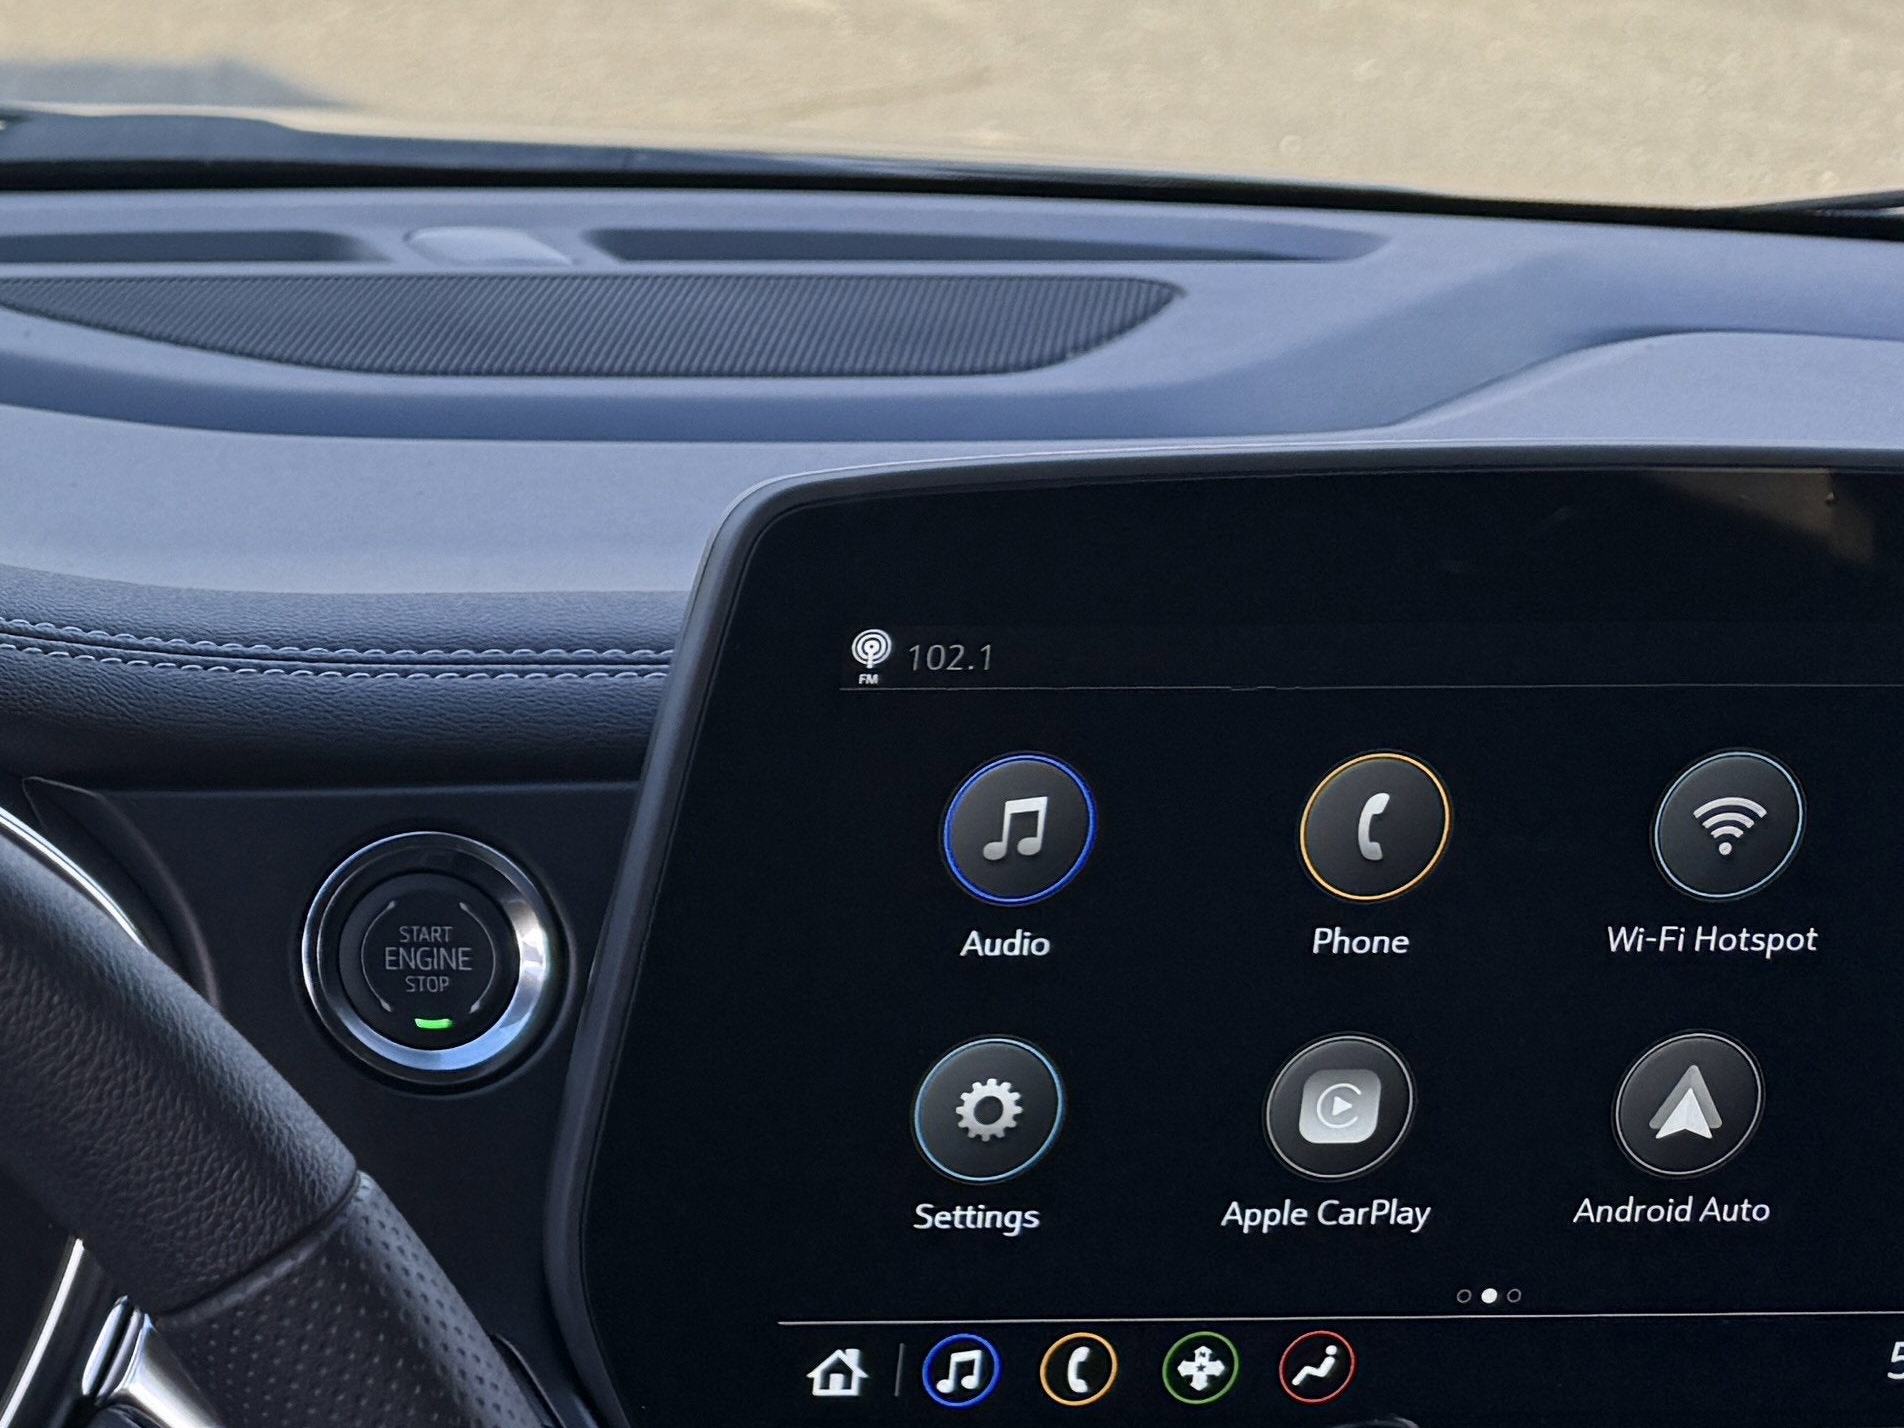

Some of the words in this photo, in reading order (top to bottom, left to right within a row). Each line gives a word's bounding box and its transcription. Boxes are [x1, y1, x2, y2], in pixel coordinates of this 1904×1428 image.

[907, 643, 992, 672] 102.1
[858, 673, 879, 685] FM
[399, 926, 452, 943] START
[959, 928, 1051, 958] Audio
[1311, 926, 1410, 955] Phone
[1607, 924, 1686, 954] Wi-Fi
[1695, 925, 1818, 960] Hotspot
[385, 947, 472, 971] ENGINE
[405, 975, 450, 993] STOP
[912, 1203, 1041, 1237] Settings
[1221, 1201, 1308, 1234] Apple
[1317, 1199, 1432, 1233] CarPlay
[1573, 1196, 1693, 1224] Android
[1699, 1196, 1771, 1223] Auto
